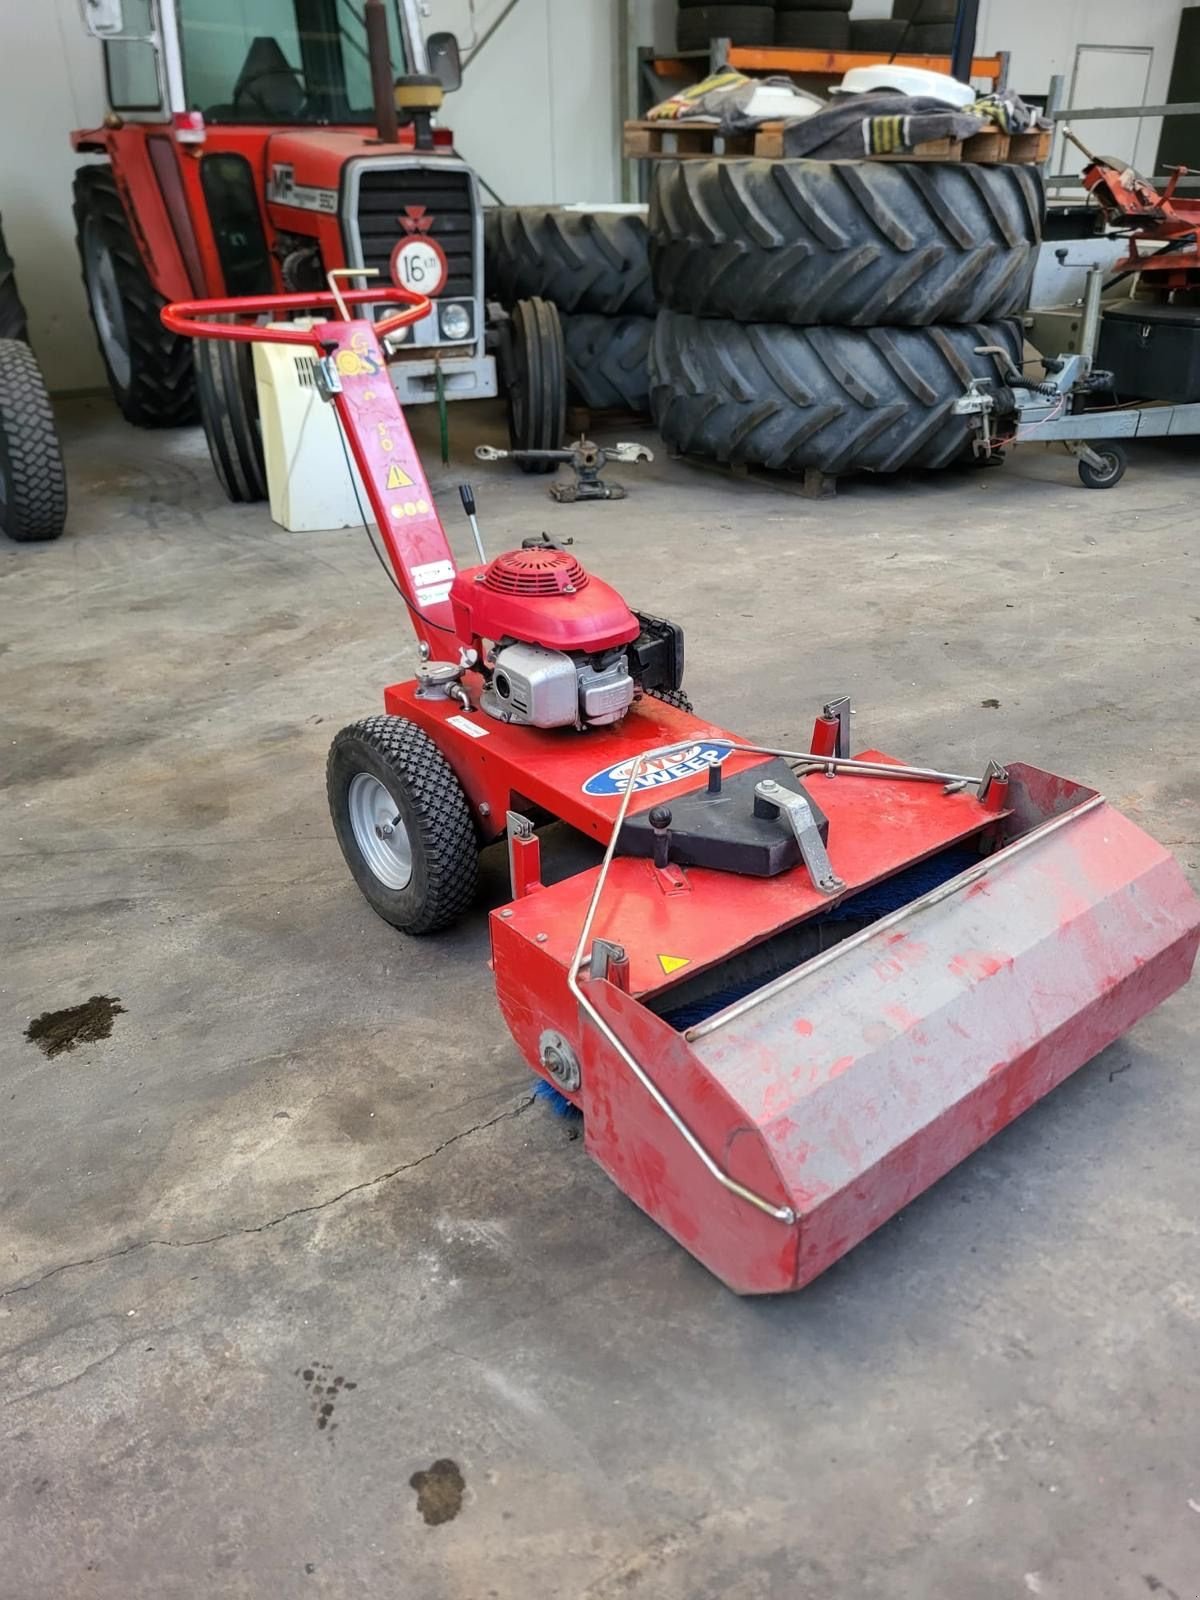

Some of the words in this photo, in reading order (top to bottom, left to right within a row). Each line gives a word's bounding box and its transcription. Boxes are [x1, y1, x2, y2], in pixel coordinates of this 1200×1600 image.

[271, 168, 293, 201] MF
[404, 255, 425, 283] 16
[615, 749, 719, 792] SWEEP
